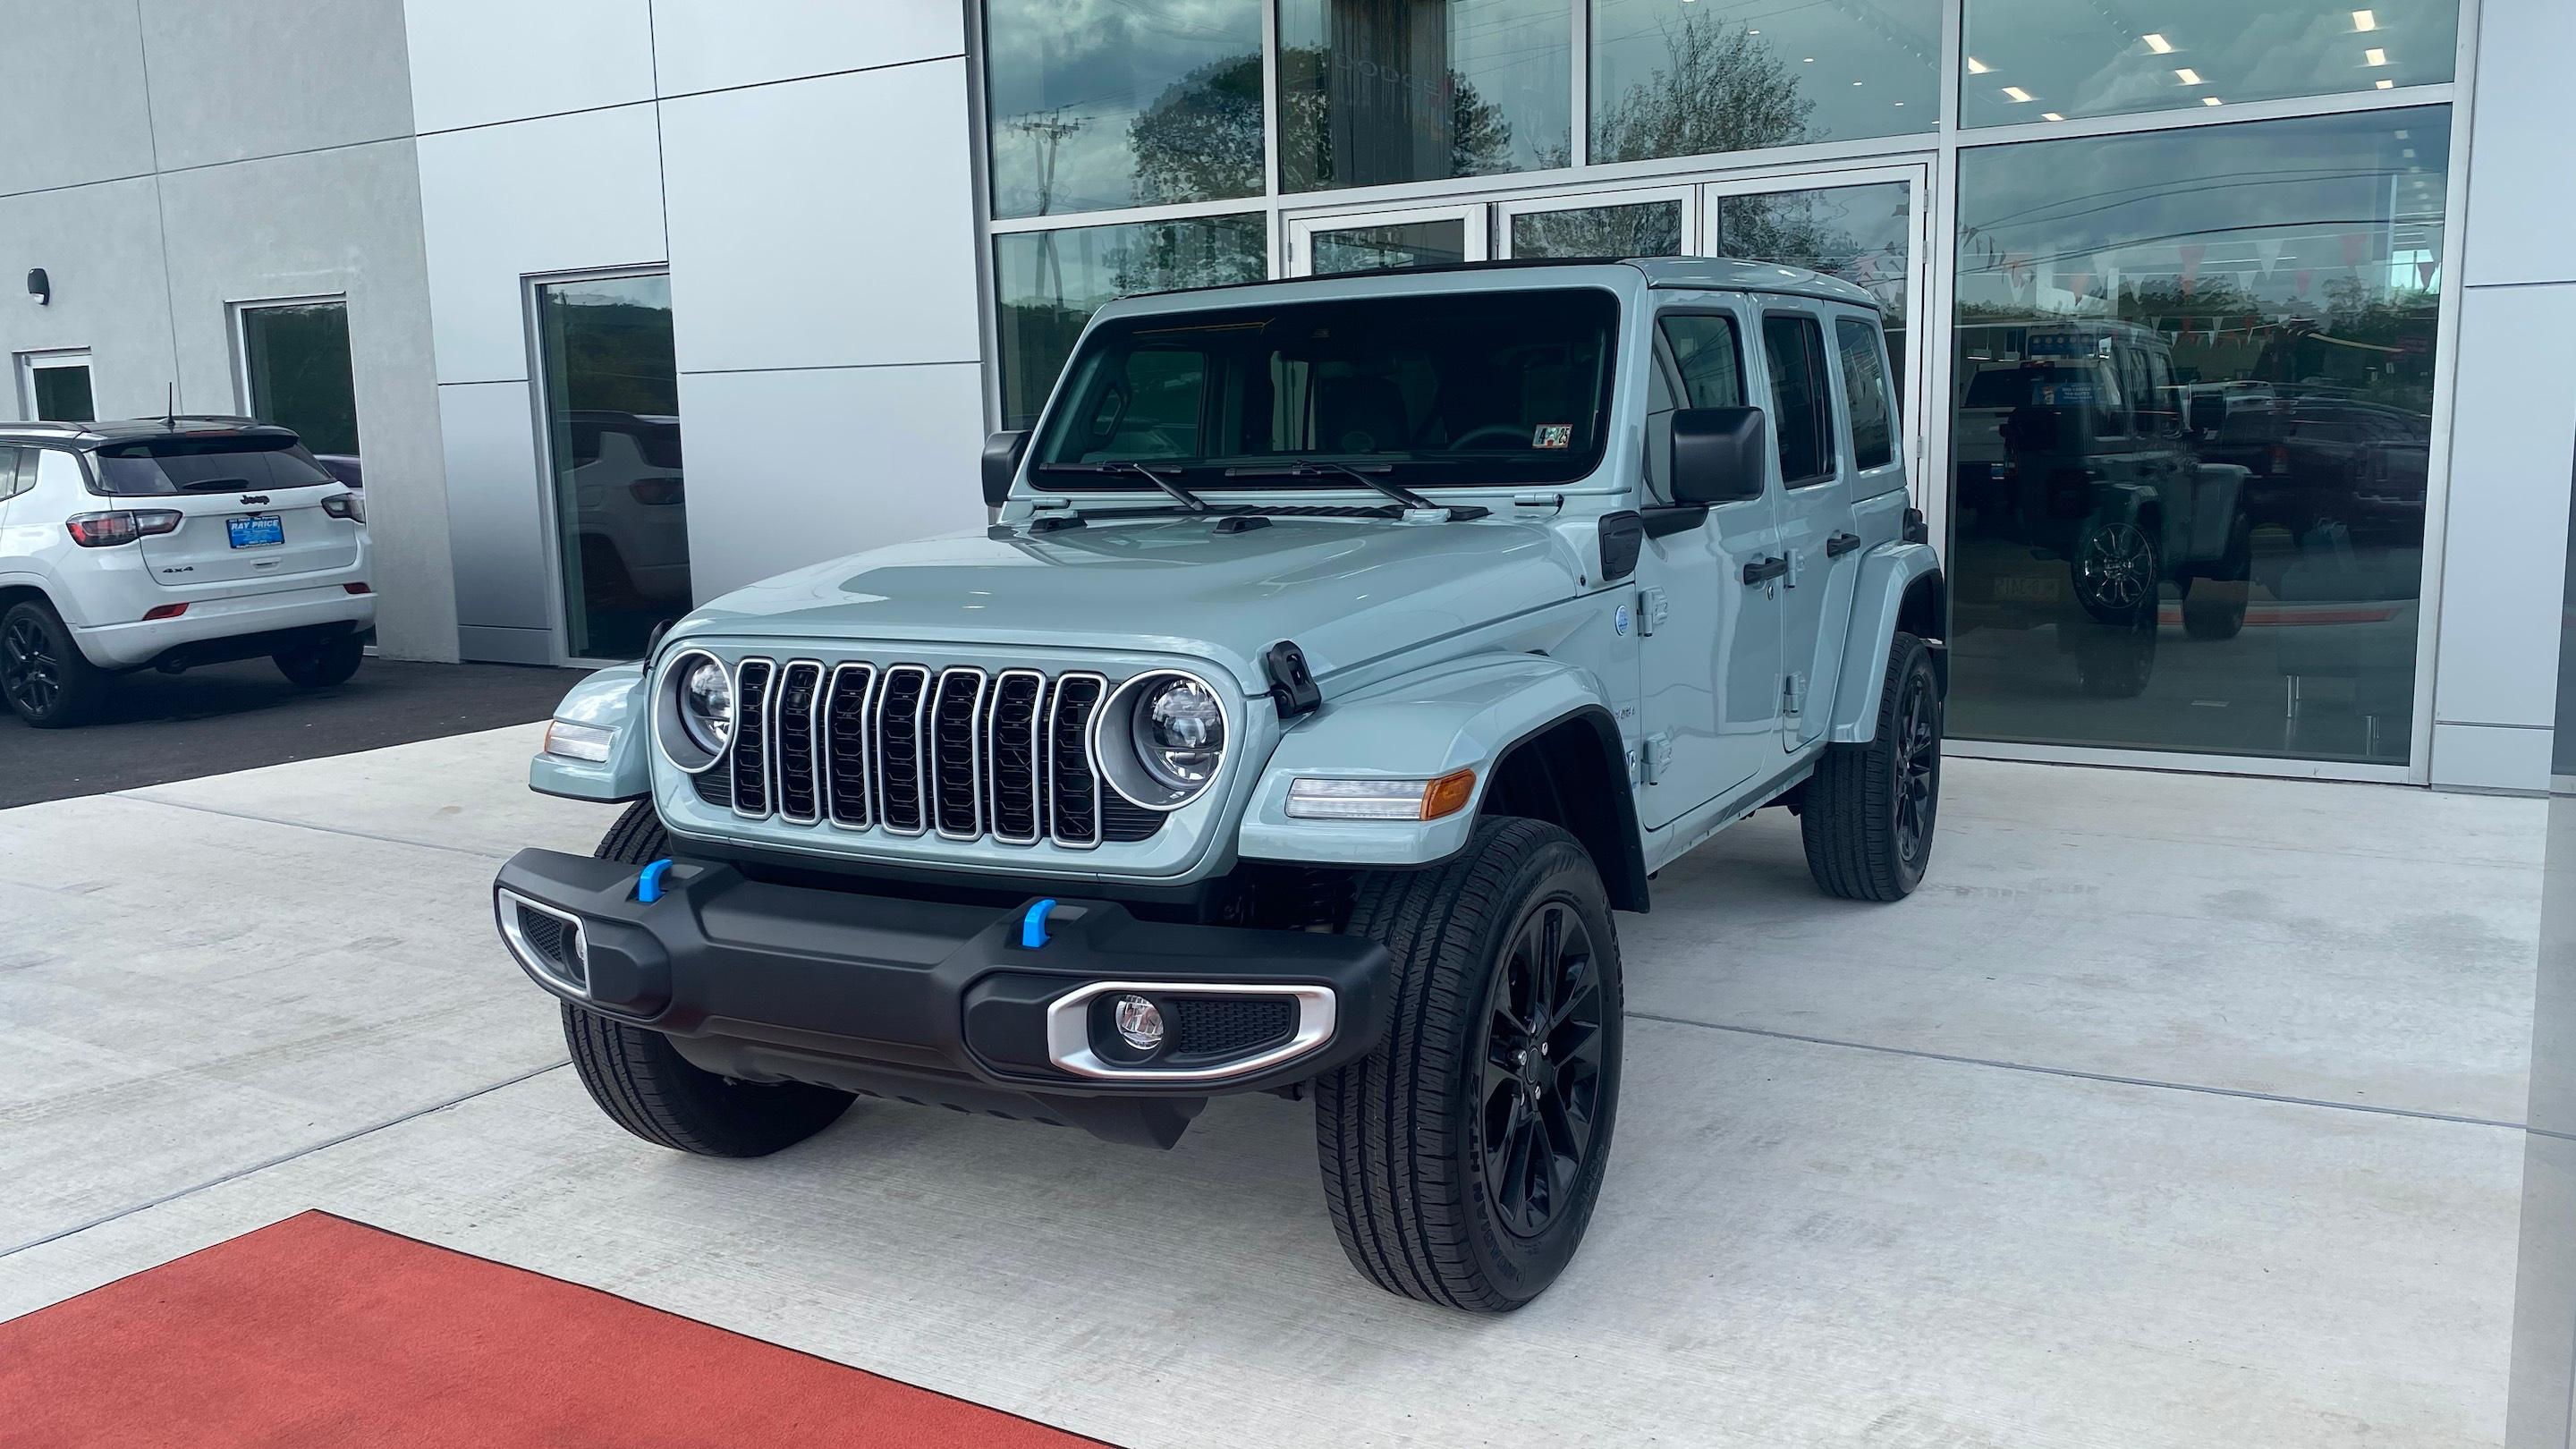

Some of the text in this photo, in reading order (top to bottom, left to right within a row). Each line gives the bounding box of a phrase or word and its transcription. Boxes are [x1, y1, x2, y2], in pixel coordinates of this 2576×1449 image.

[1559, 428, 1570, 444] 25
[240, 495, 270, 504] Jeep
[231, 522, 250, 530] RAY
[251, 520, 279, 529] PRICE
